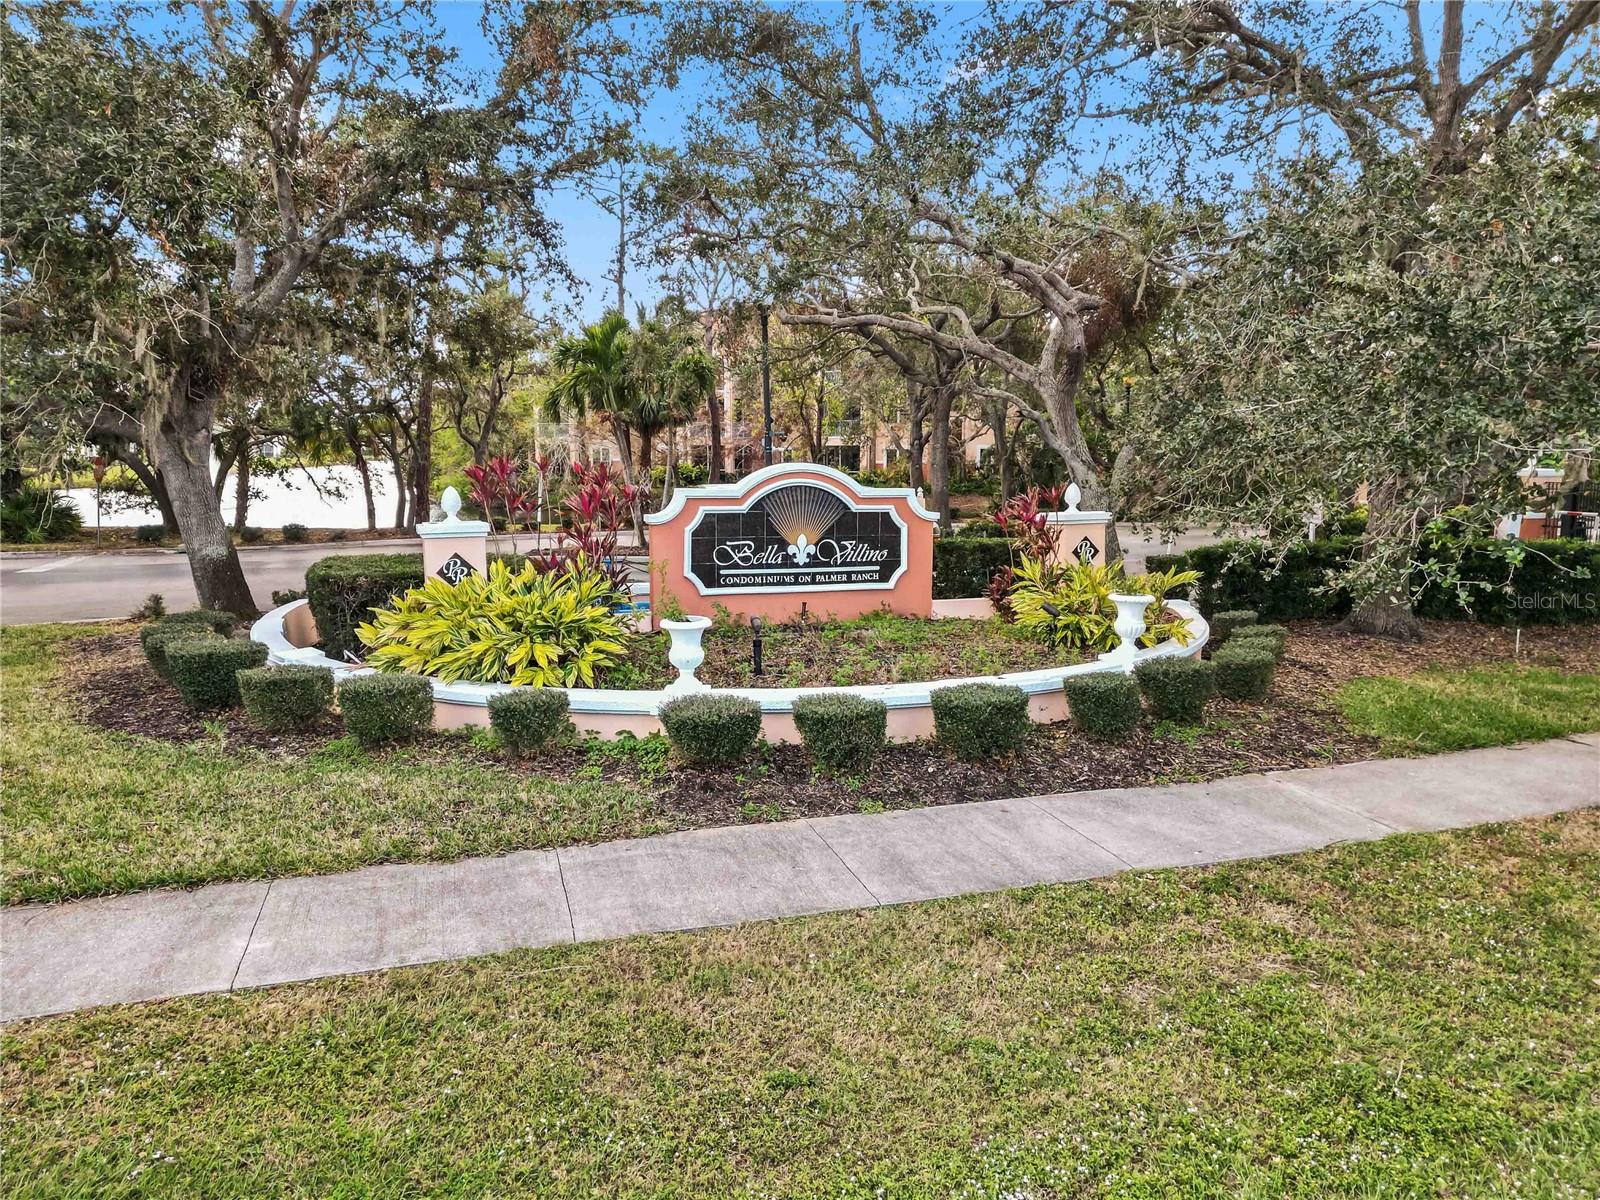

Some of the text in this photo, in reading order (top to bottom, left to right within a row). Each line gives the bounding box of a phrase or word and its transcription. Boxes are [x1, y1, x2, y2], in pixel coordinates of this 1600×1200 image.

[712, 538, 889, 567] Bella Villino
[798, 574, 811, 583] ON
[815, 573, 848, 583] PALMER
[851, 572, 880, 581] RANCH
